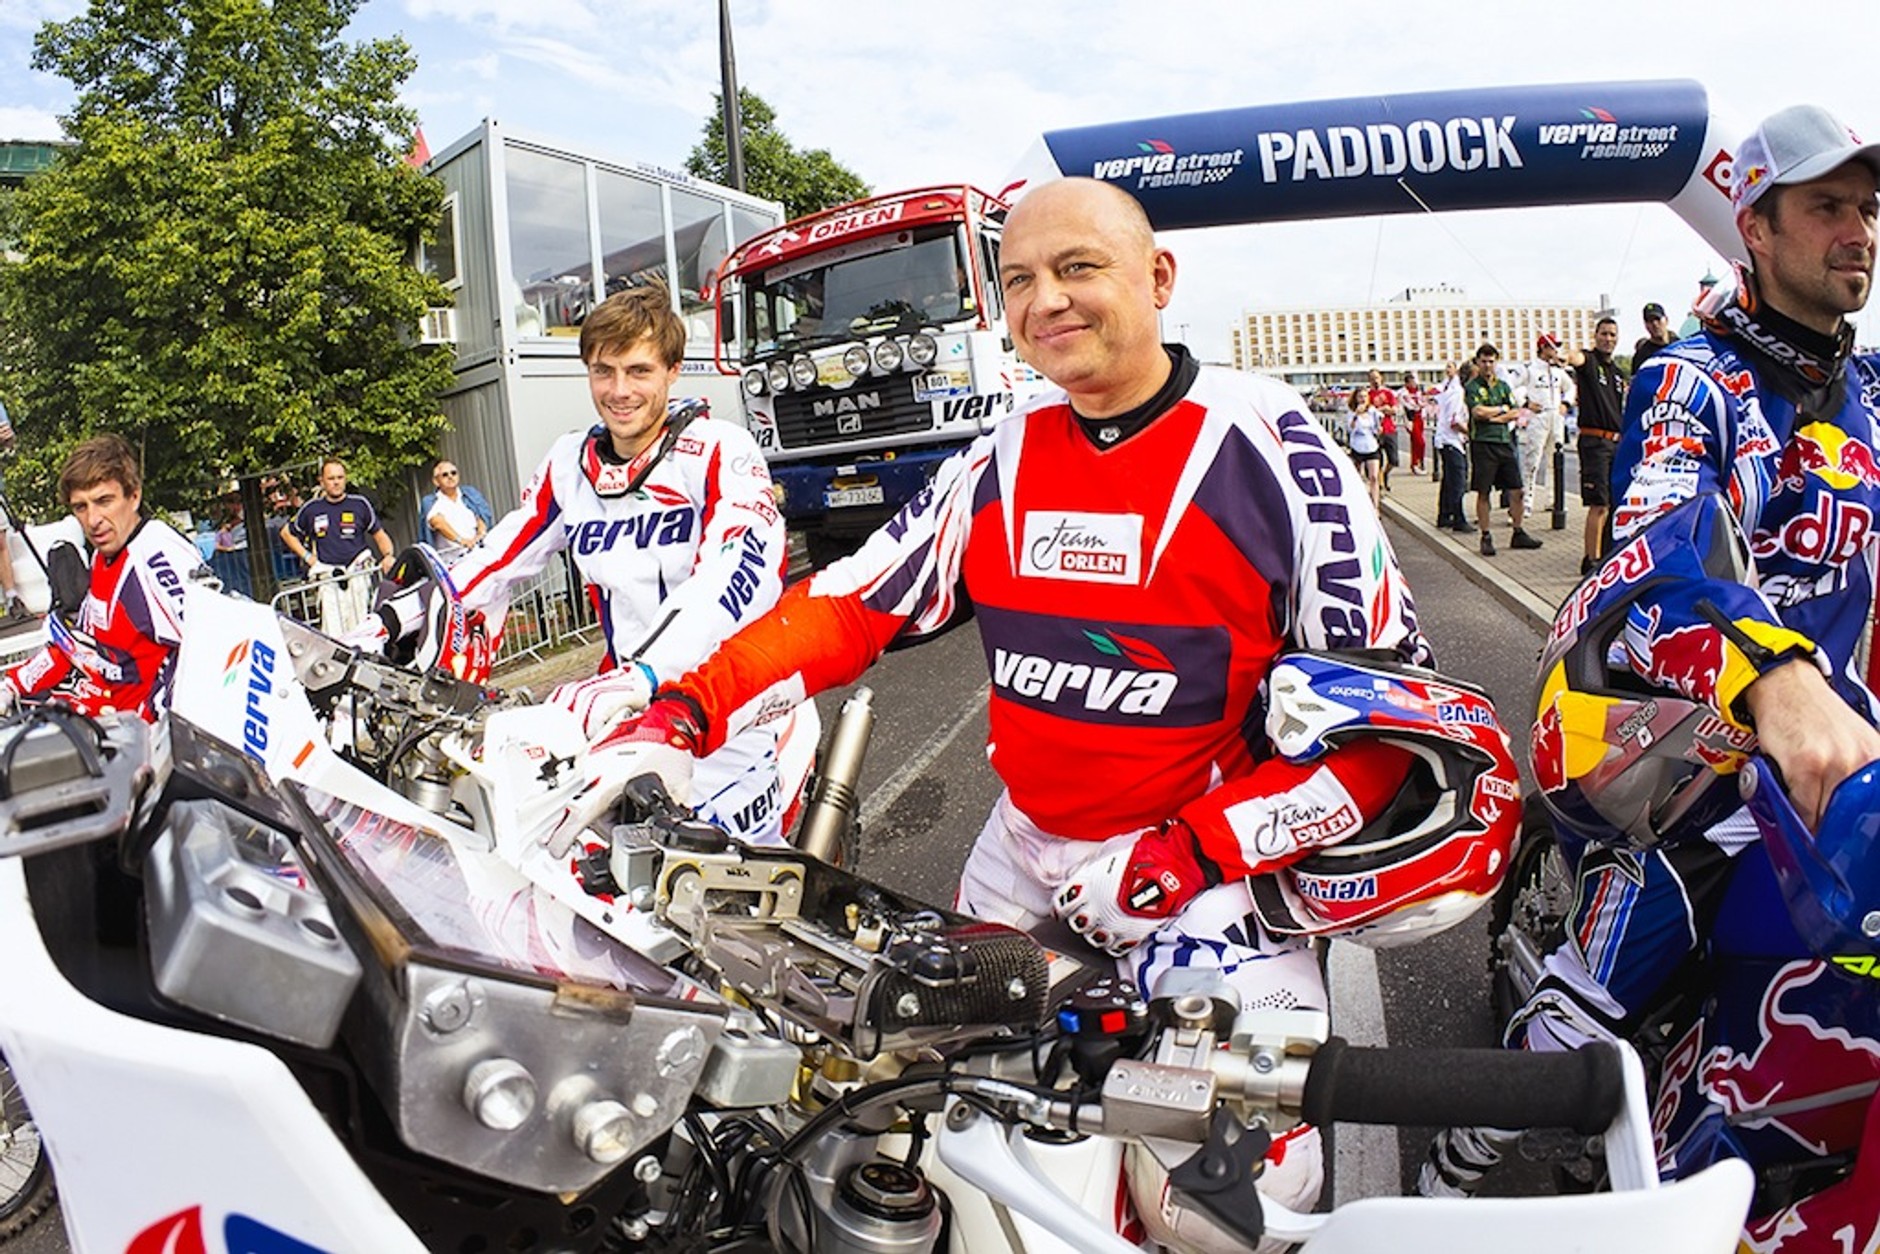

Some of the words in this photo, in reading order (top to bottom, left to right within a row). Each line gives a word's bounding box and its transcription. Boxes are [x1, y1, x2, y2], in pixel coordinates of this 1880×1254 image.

[1257, 115, 1524, 183] PADDOCK
[1538, 123, 1618, 145] verva
[1618, 125, 1679, 142] street
[1093, 153, 1176, 180] verva
[1175, 149, 1244, 171] street
[1580, 142, 1643, 160] racing
[1137, 169, 1205, 189] racing
[814, 206, 897, 239] ORLEN
[1723, 306, 1819, 366] RUDY
[812, 391, 881, 417] MAN
[1276, 409, 1368, 651] verva
[1062, 552, 1124, 574] ORLEN
[146, 550, 186, 622] ver
[994, 648, 1179, 716] verva
[242, 639, 277, 765] verva
[1699, 716, 1752, 748] Bull
[1485, 779, 1513, 798] ORLEN
[732, 776, 780, 834] ver
[1292, 807, 1354, 844] ORLEN
[1299, 876, 1376, 900] verva
